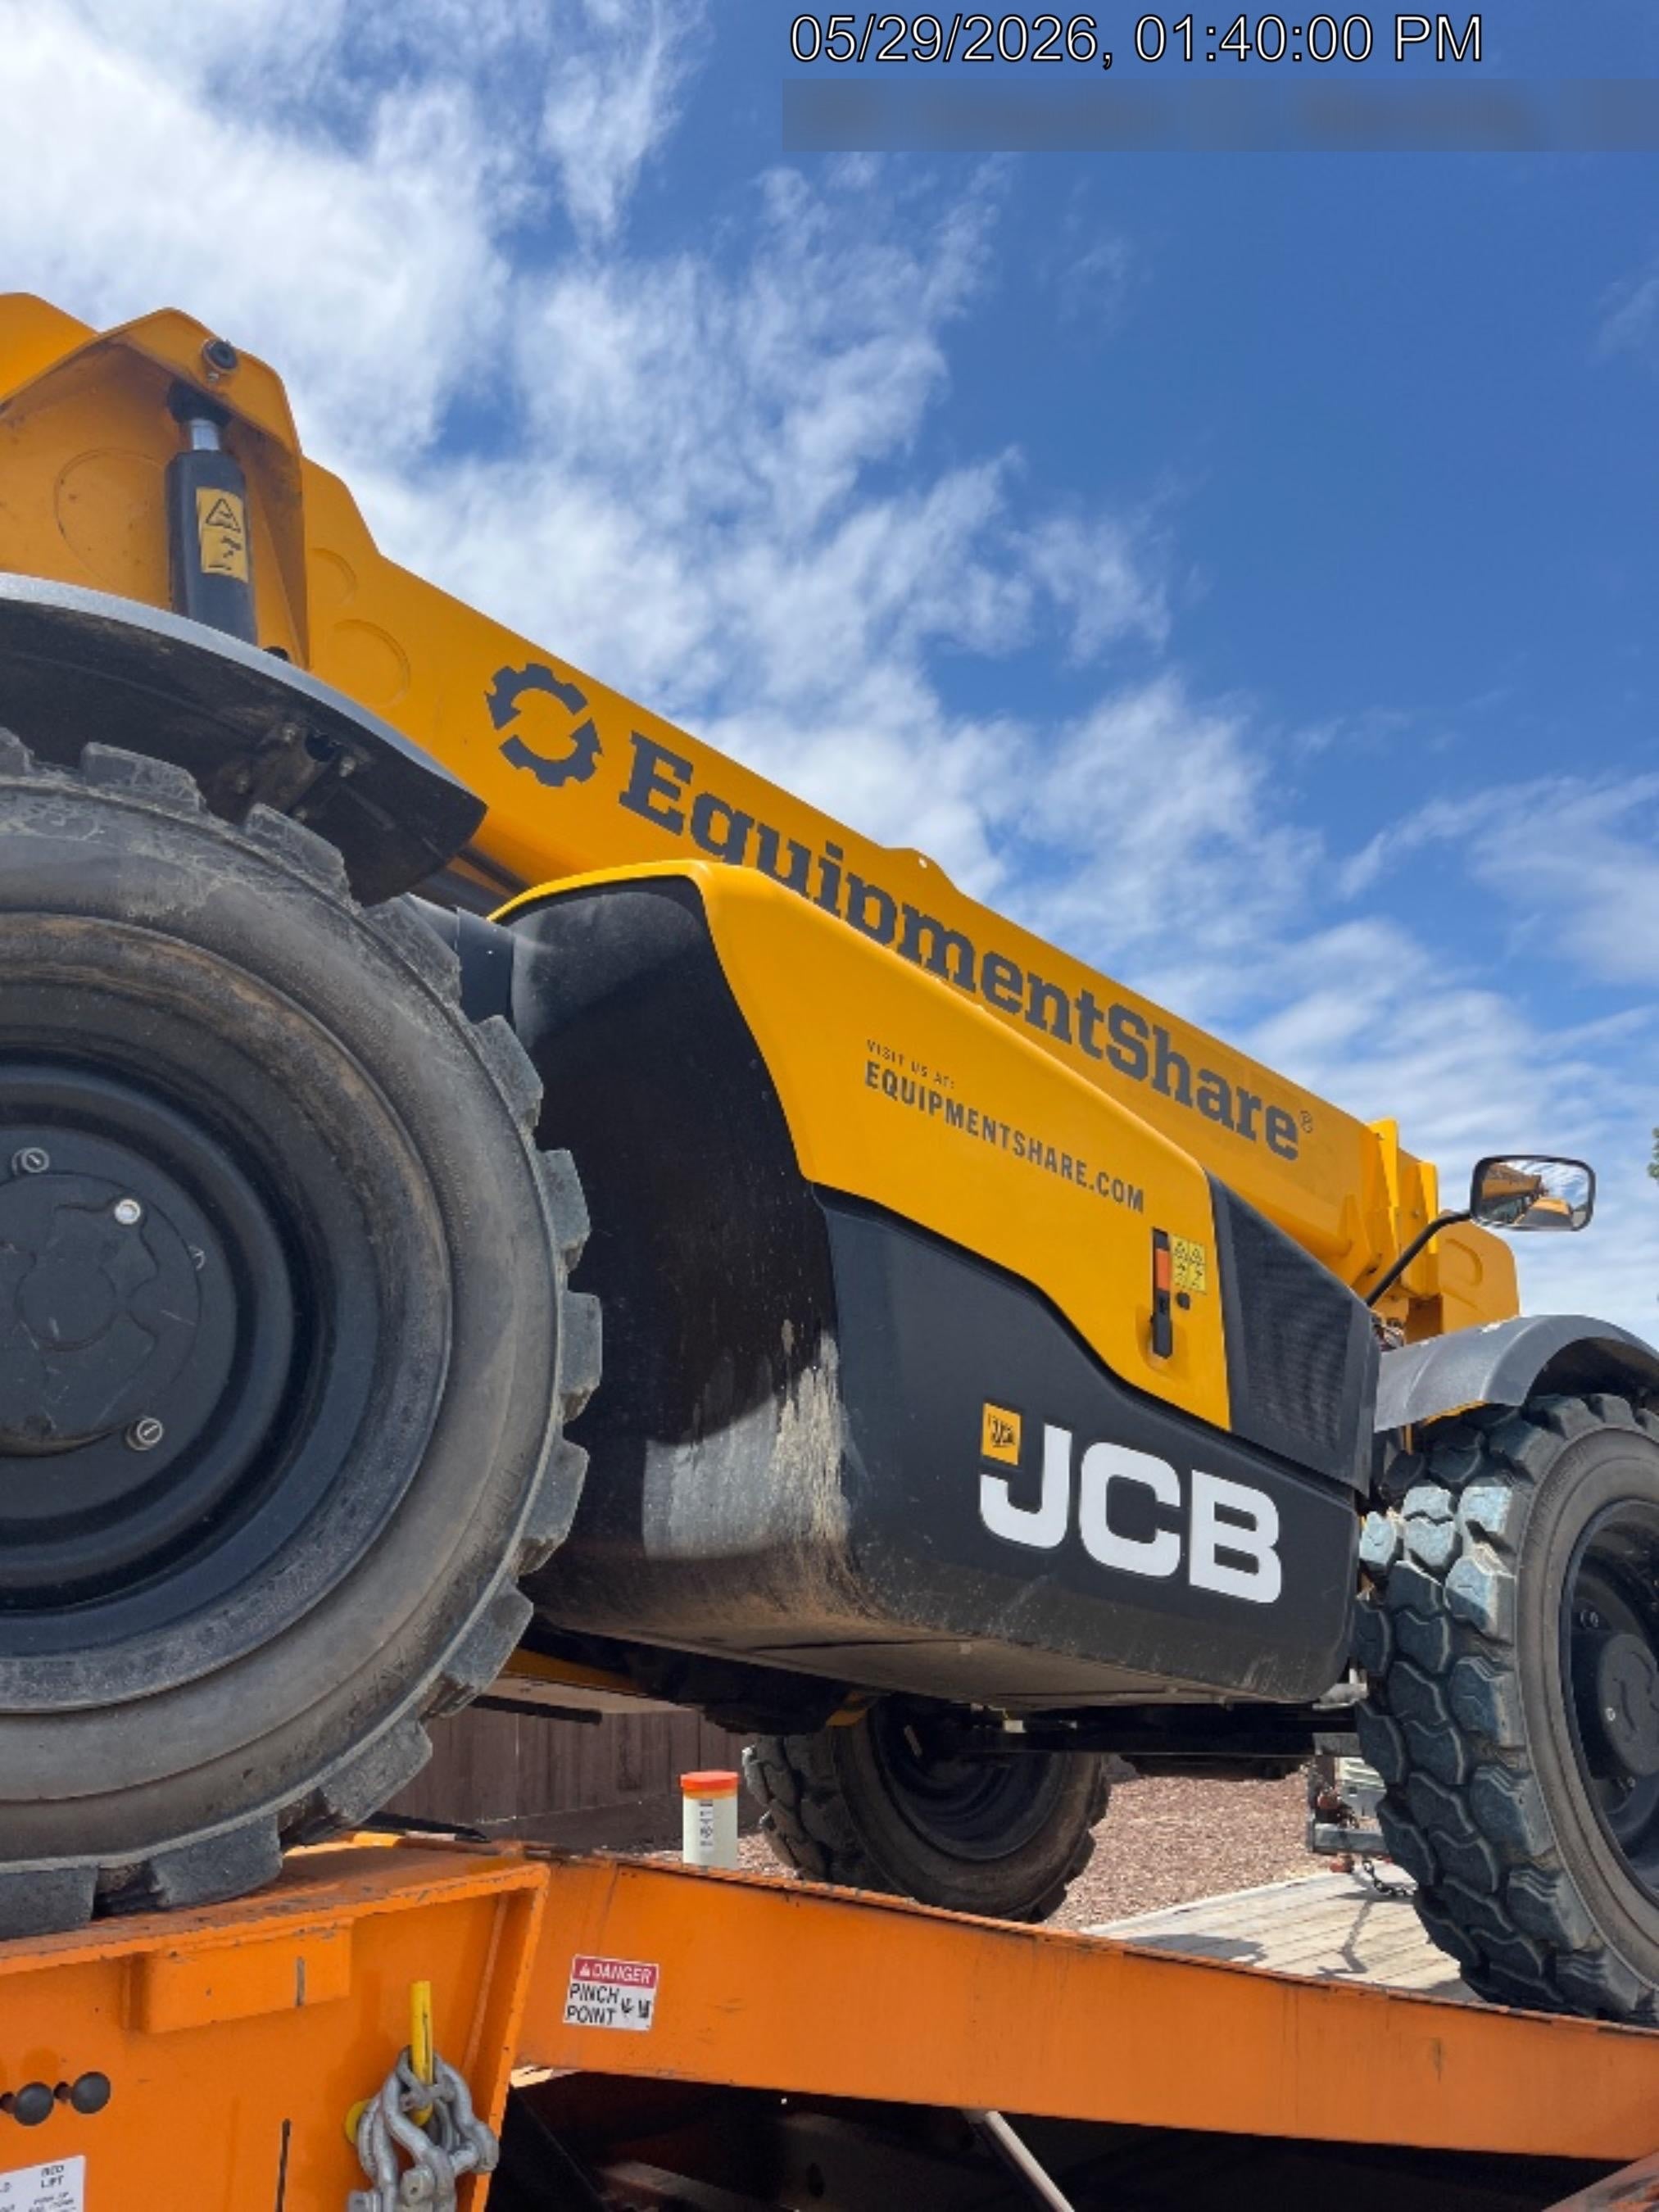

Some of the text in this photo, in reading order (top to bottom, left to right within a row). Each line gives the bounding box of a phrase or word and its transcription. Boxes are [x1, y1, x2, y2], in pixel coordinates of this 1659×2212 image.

[867, 1039, 904, 1067] VISIT
[911, 1061, 927, 1077] US
[865, 1060, 1143, 1213] EQUIPMENTSHARE.COM
[980, 1423, 1282, 1604] JCB
[592, 1963, 652, 1984] DANGER
[570, 1983, 619, 2004] PINCH
[567, 2005, 617, 2025] POINT
